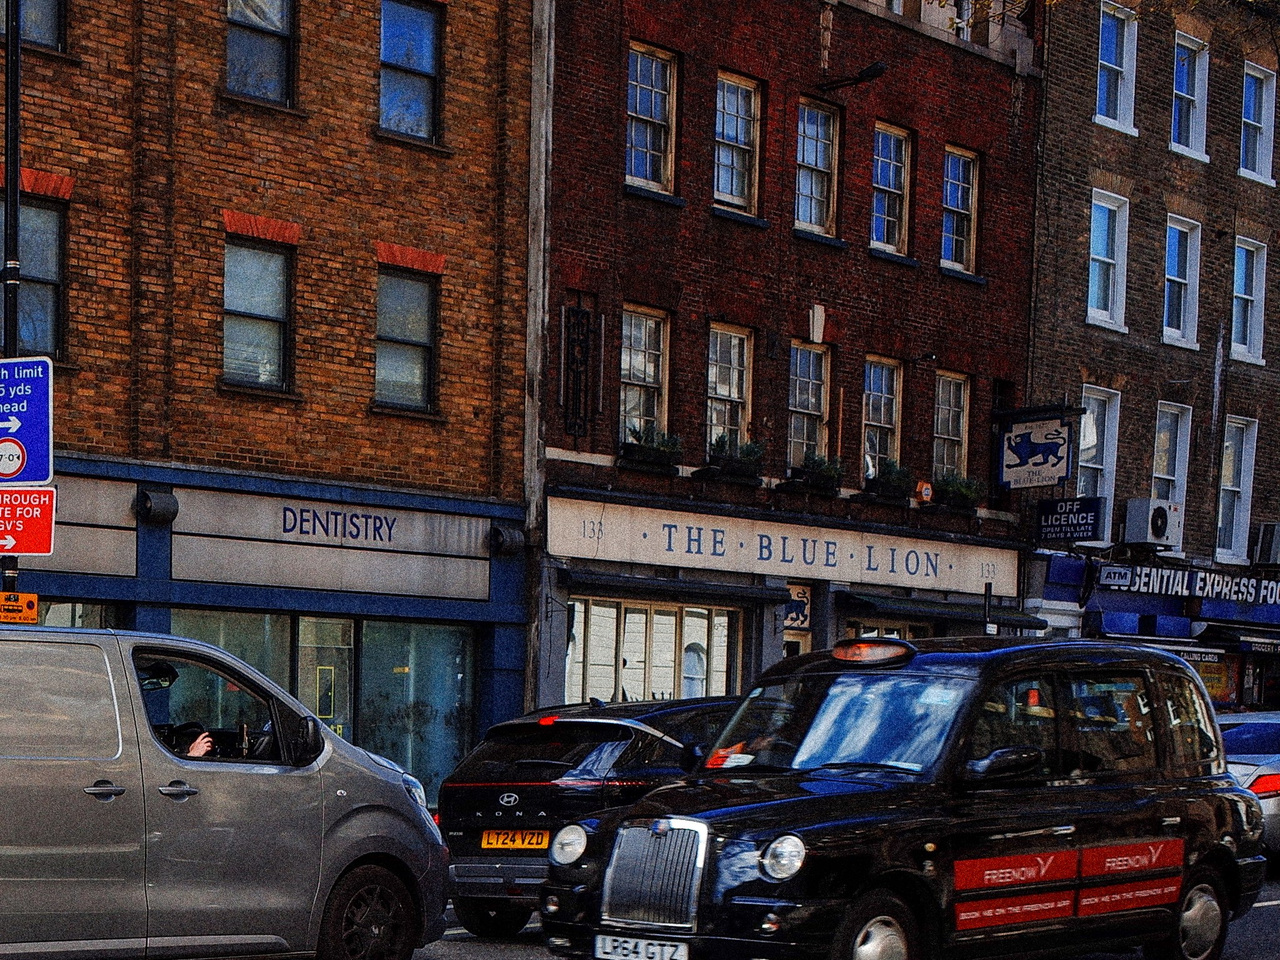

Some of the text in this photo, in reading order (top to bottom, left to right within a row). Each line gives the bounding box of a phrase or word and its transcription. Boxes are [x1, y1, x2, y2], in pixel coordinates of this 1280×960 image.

[15, 366, 43, 379] limit
[9, 383, 32, 398] yds
[16, 507, 41, 518] FOR
[1057, 501, 1080, 513] OFF
[282, 506, 397, 542] DENTISTRY
[1041, 512, 1095, 526] LICENCE
[581, 519, 996, 579] 133 THE BLUE LION 133
[1105, 571, 1128, 581] ATM
[1195, 572, 1257, 603] EXPRESS
[1181, 652, 1219, 662] CALLING CARDS
[486, 831, 544, 846] LT24 VZD
